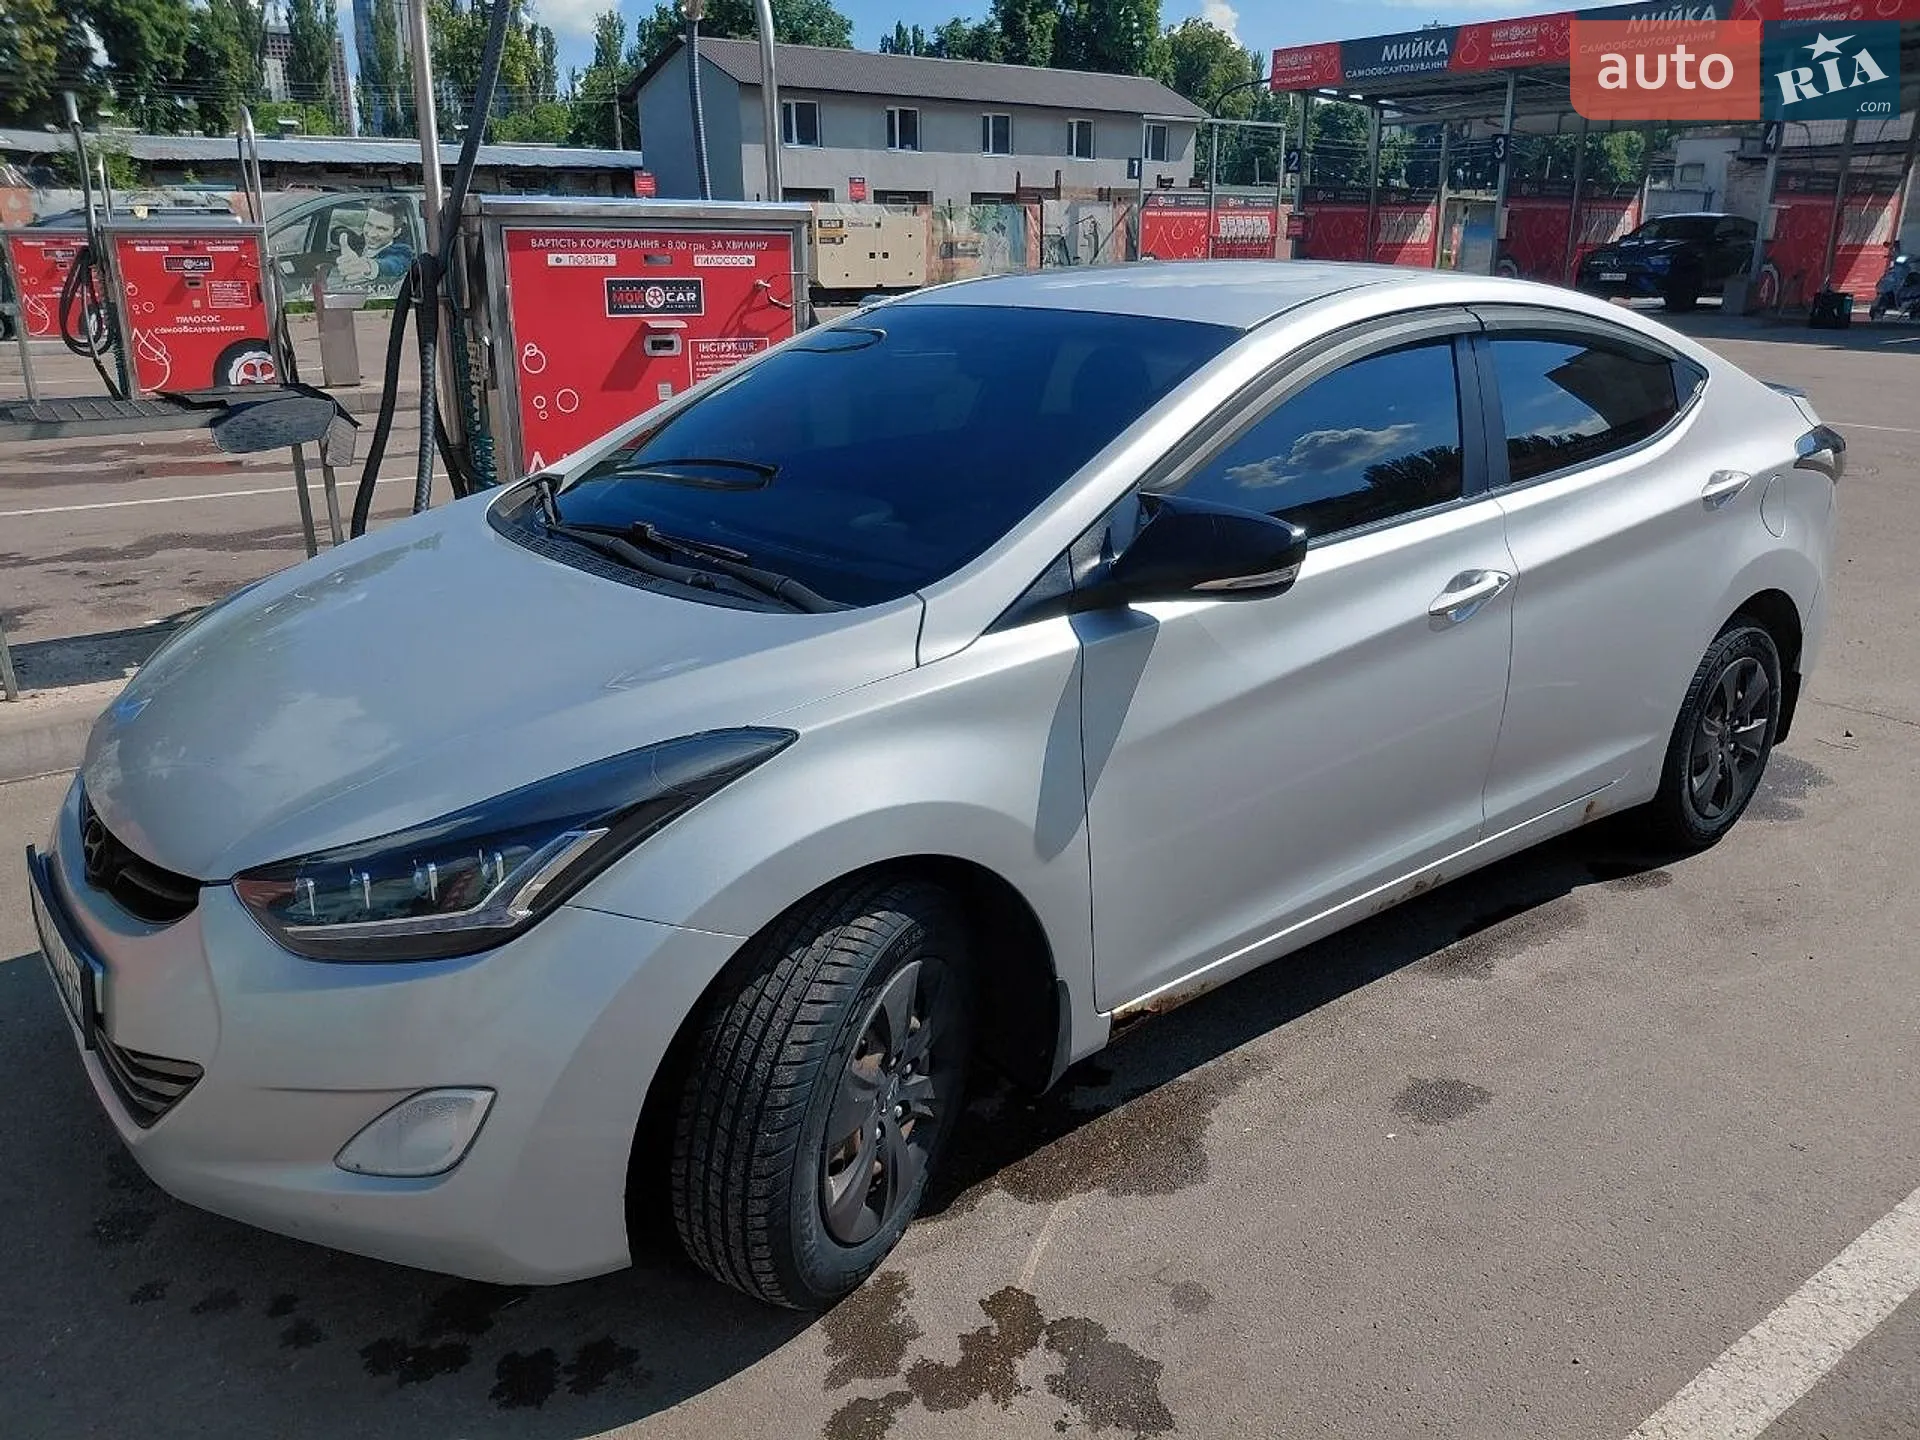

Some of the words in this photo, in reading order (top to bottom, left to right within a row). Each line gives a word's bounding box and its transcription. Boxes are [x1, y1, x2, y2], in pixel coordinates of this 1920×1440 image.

[1381, 37, 1449, 61] МИЙКА
[1766, 124, 1777, 149] 4
[1494, 137, 1505, 159] 3
[1132, 160, 1139, 177] 1
[1288, 151, 1299, 171] 2
[530, 238, 577, 249] ВАРТІСТЬ
[580, 239, 660, 250] КОРИСТУВАННЯ
[711, 240, 724, 250] ЗА
[726, 240, 768, 251] ХВИЛИНУ
[568, 255, 609, 265] ПОВІТРЯ
[696, 256, 746, 265] ПИЛОСОС
[666, 292, 697, 302] CAR
[176, 314, 221, 324] ПИЛОСОС
